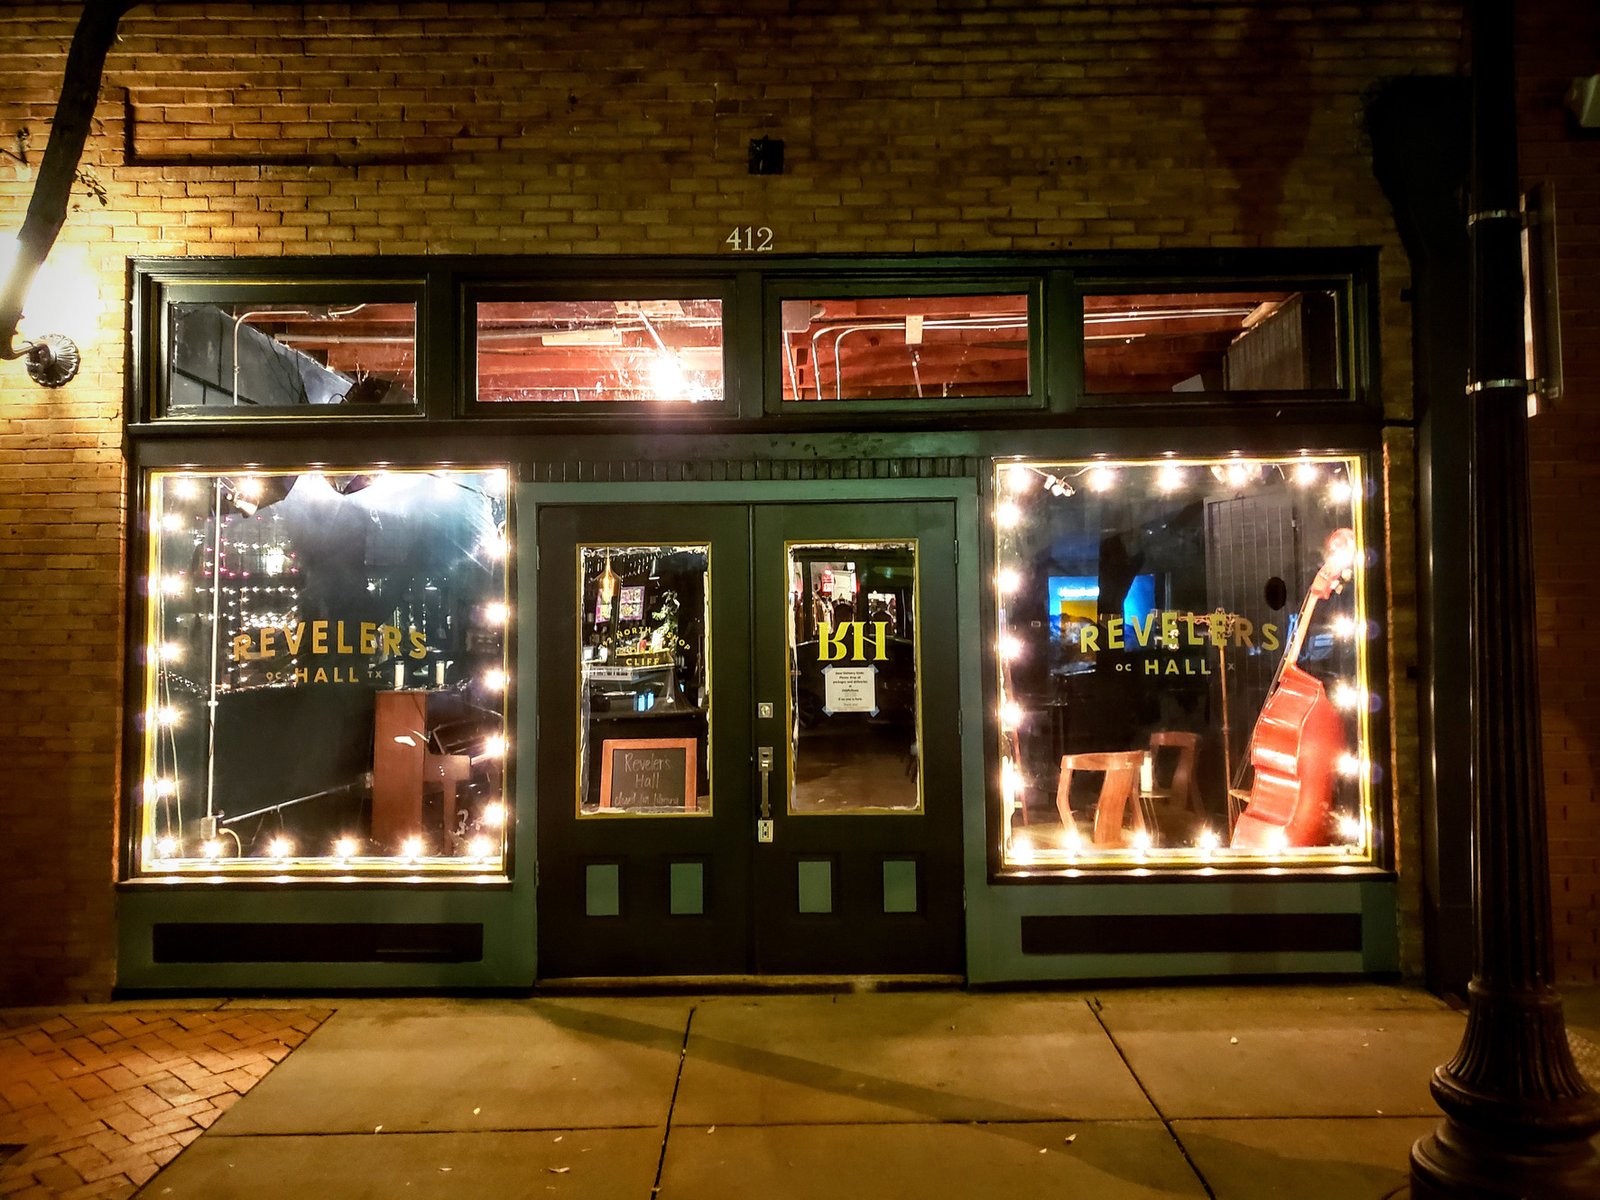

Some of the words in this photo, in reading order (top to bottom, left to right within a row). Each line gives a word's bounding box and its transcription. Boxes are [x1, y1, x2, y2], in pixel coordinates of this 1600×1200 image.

[726, 226, 773, 251] 412
[233, 620, 427, 662] REVELERS
[616, 626, 651, 639] NORTH
[1080, 612, 1280, 653] REVELERS
[626, 658, 660, 666] CLIFF
[1115, 663, 1132, 672] OC
[1145, 659, 1212, 675] HALL
[266, 671, 282, 681] OC
[295, 667, 359, 684] HALL
[367, 671, 382, 680] TX
[635, 772, 660, 789] Hall
